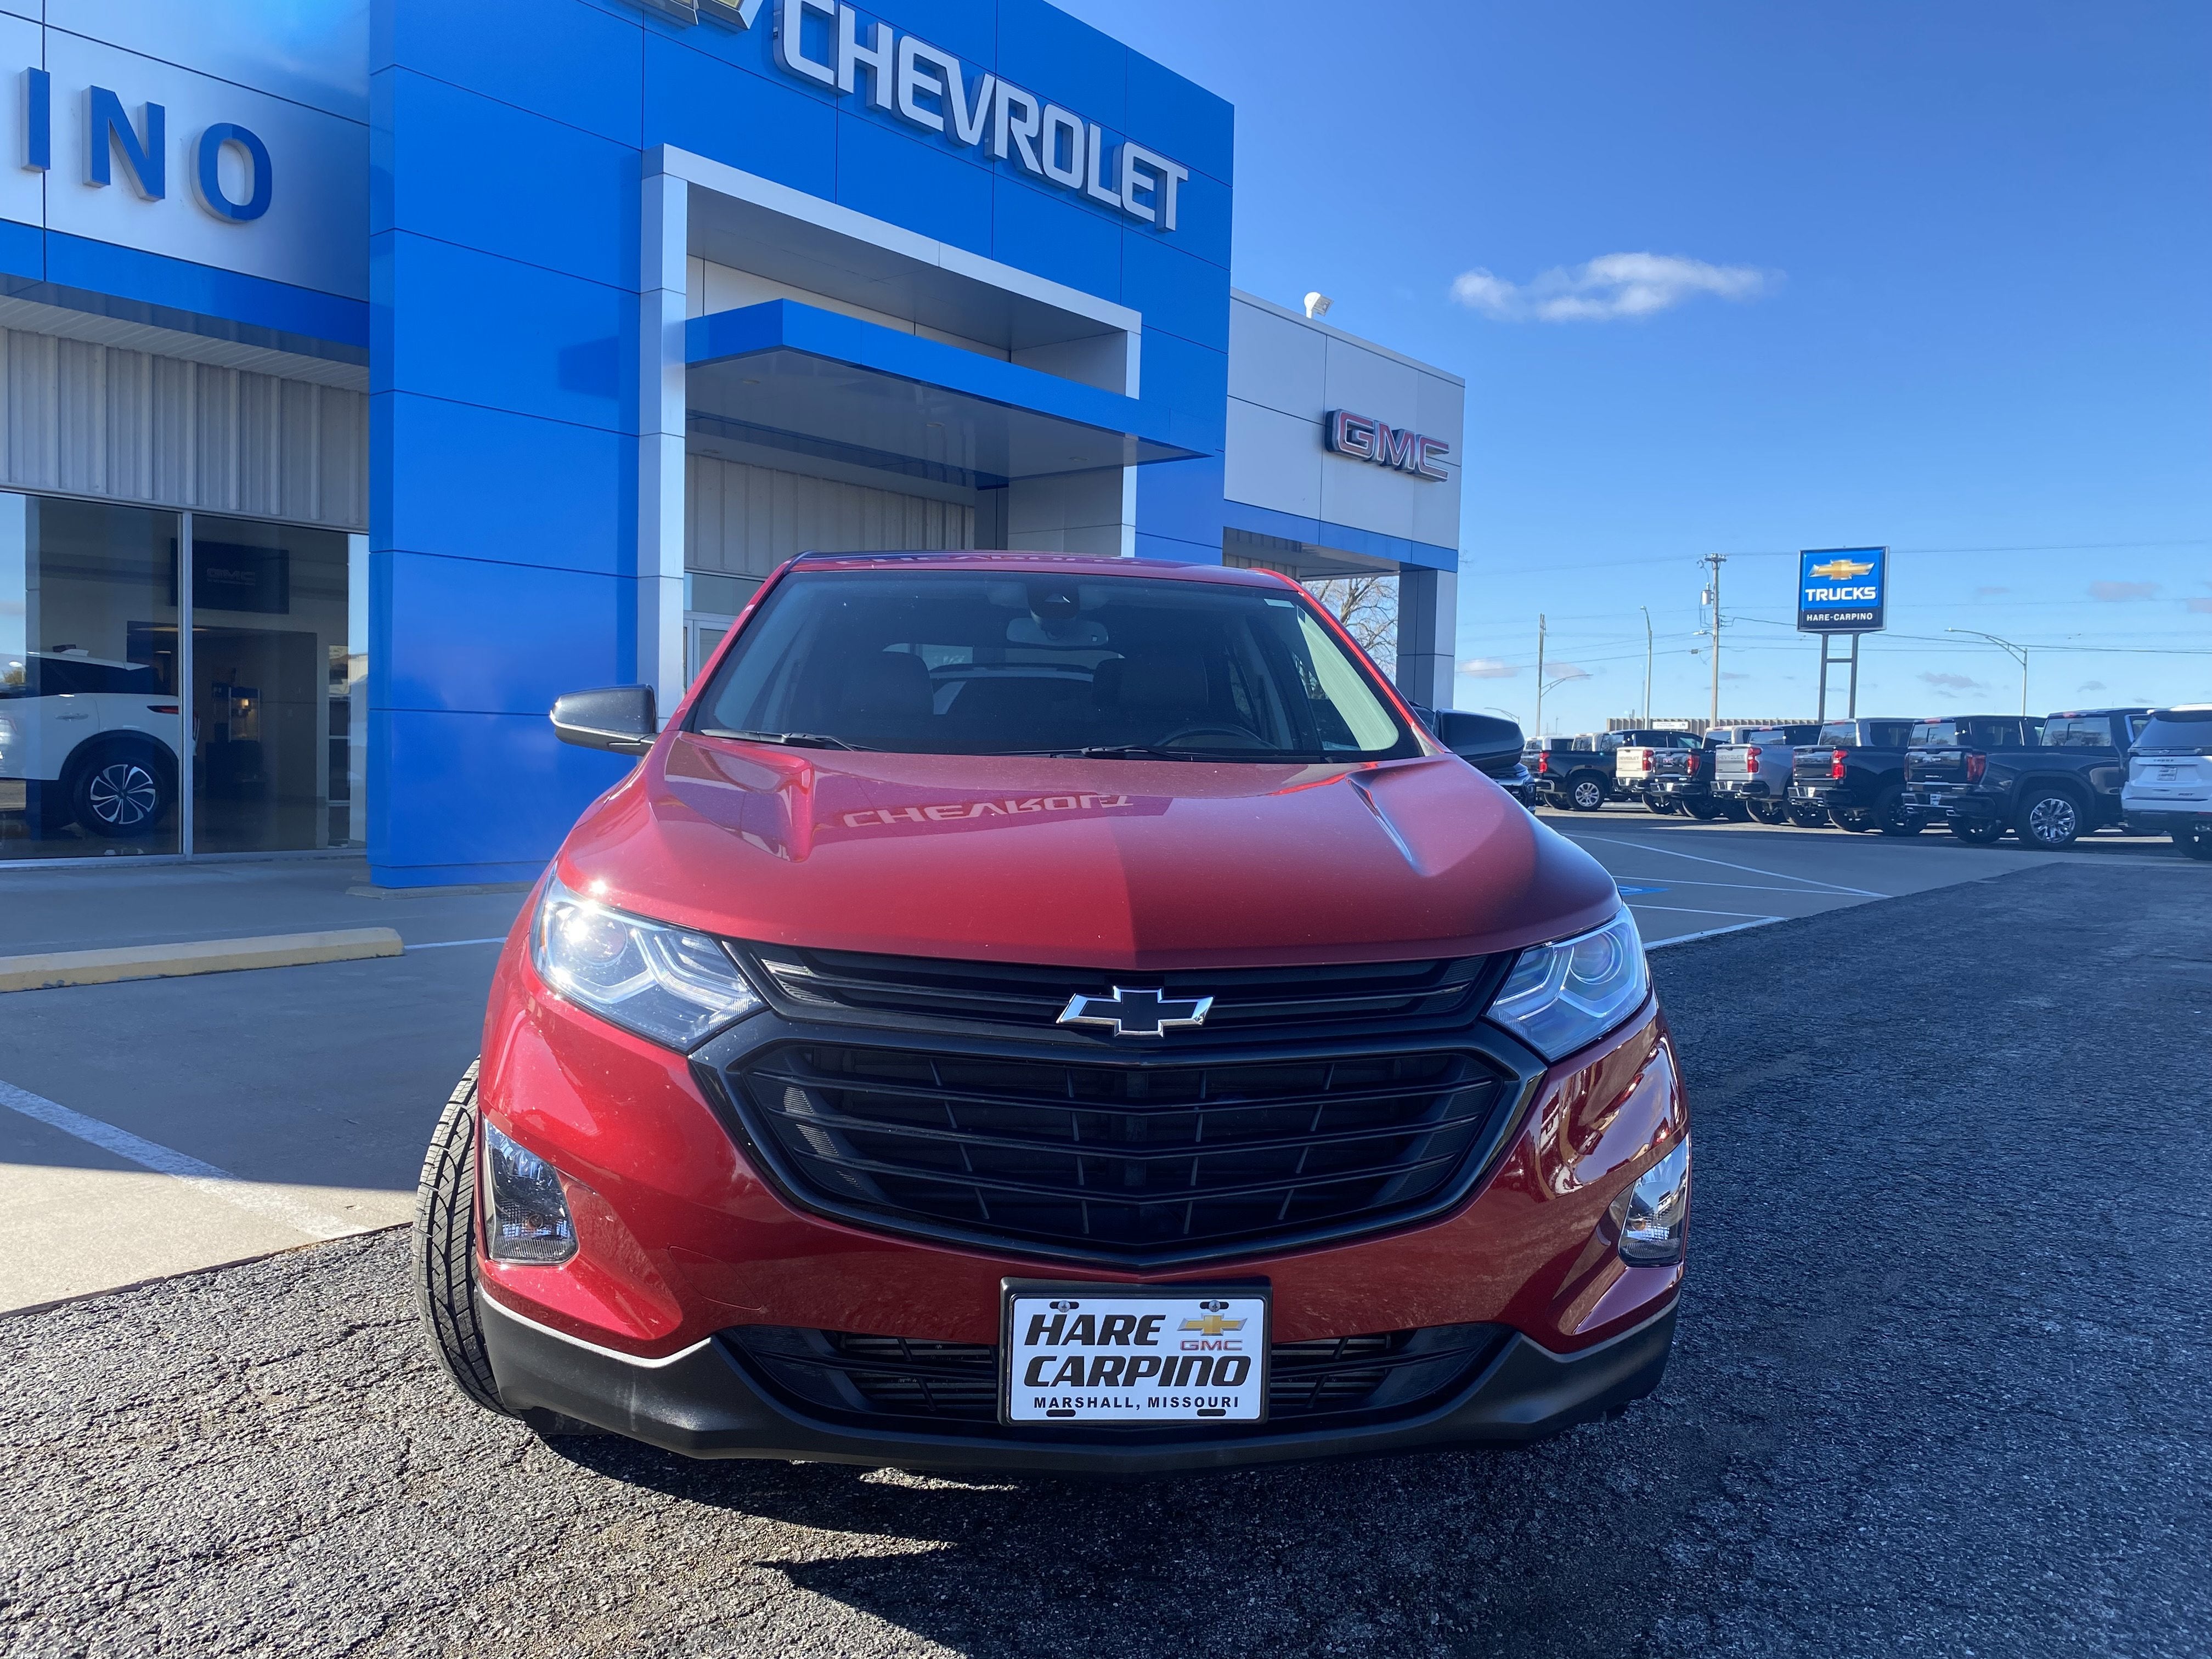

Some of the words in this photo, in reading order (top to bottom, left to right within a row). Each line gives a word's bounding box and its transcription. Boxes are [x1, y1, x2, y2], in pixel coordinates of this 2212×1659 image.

[774, 0, 1188, 232] CHEVROLET
[1325, 409, 1450, 482] GMC
[1805, 586, 1876, 601] TRUCKS
[1807, 612, 1873, 622] HARE-CARPINO
[1024, 1314, 1166, 1346] HARE
[1180, 1339, 1243, 1351] GMC
[1023, 1356, 1251, 1387] CARPINO
[1034, 1396, 1141, 1410] MARSHALL,
[1148, 1396, 1239, 1408] MISSOURI
